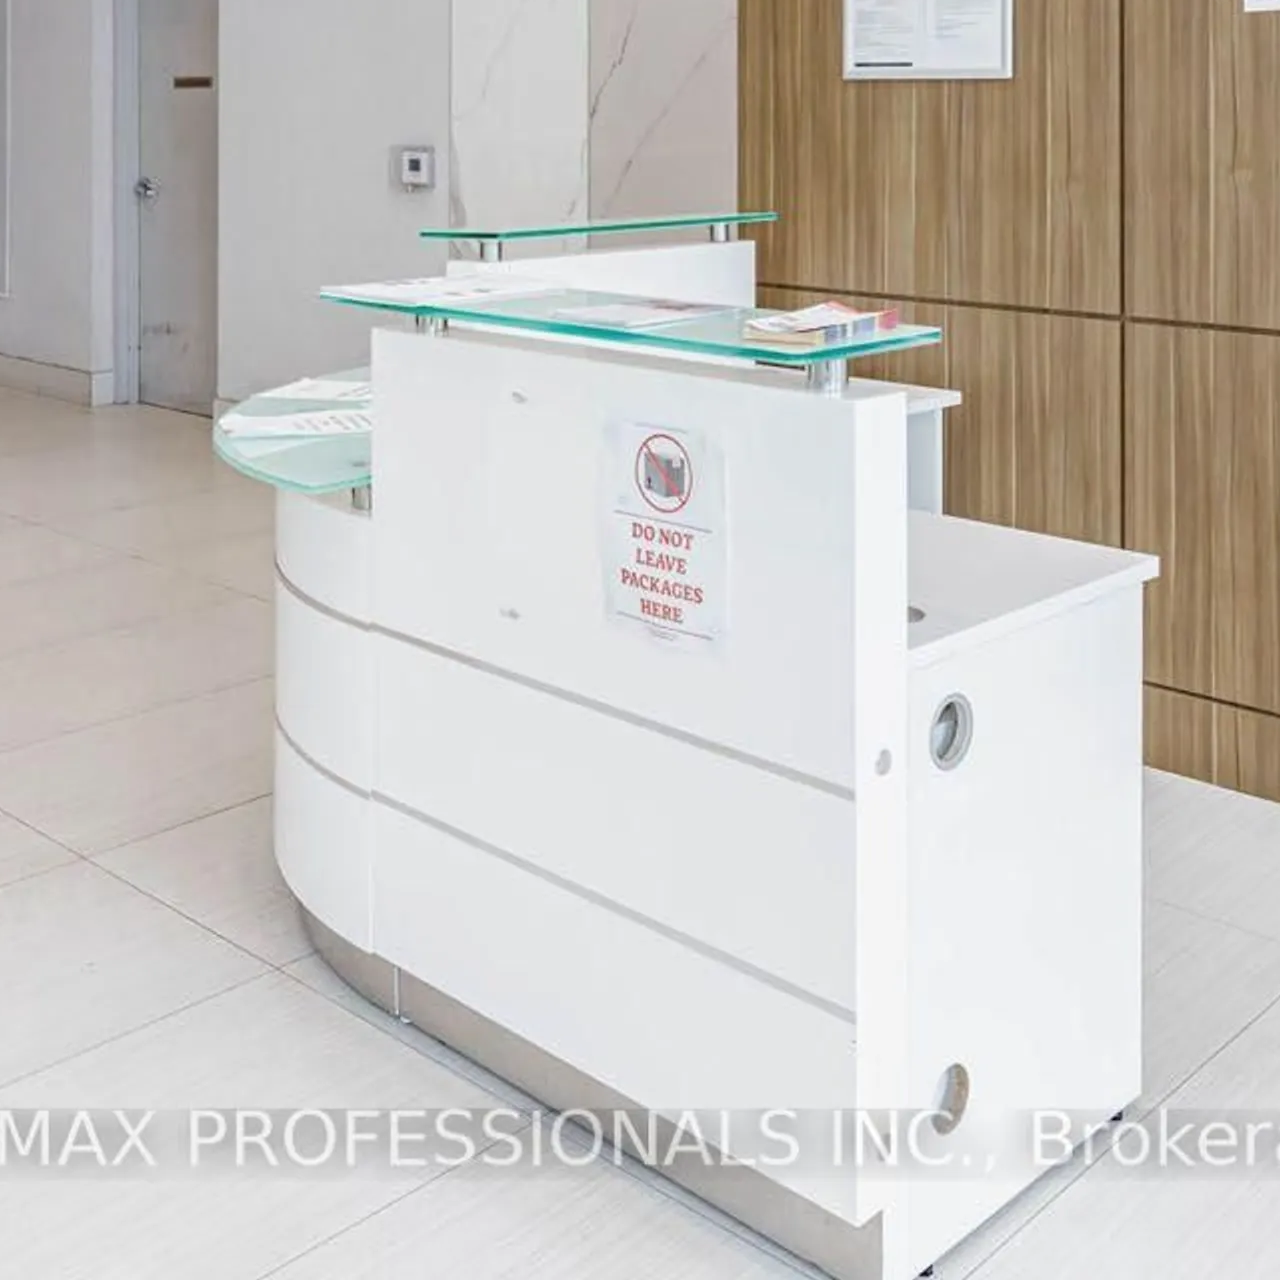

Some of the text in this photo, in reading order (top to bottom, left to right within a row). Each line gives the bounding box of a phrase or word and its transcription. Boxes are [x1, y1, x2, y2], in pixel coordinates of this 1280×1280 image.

[631, 521, 695, 552] DO NOT
[635, 547, 688, 576] LEAVE
[619, 567, 704, 605] PACKAGES
[639, 598, 684, 624] HERE
